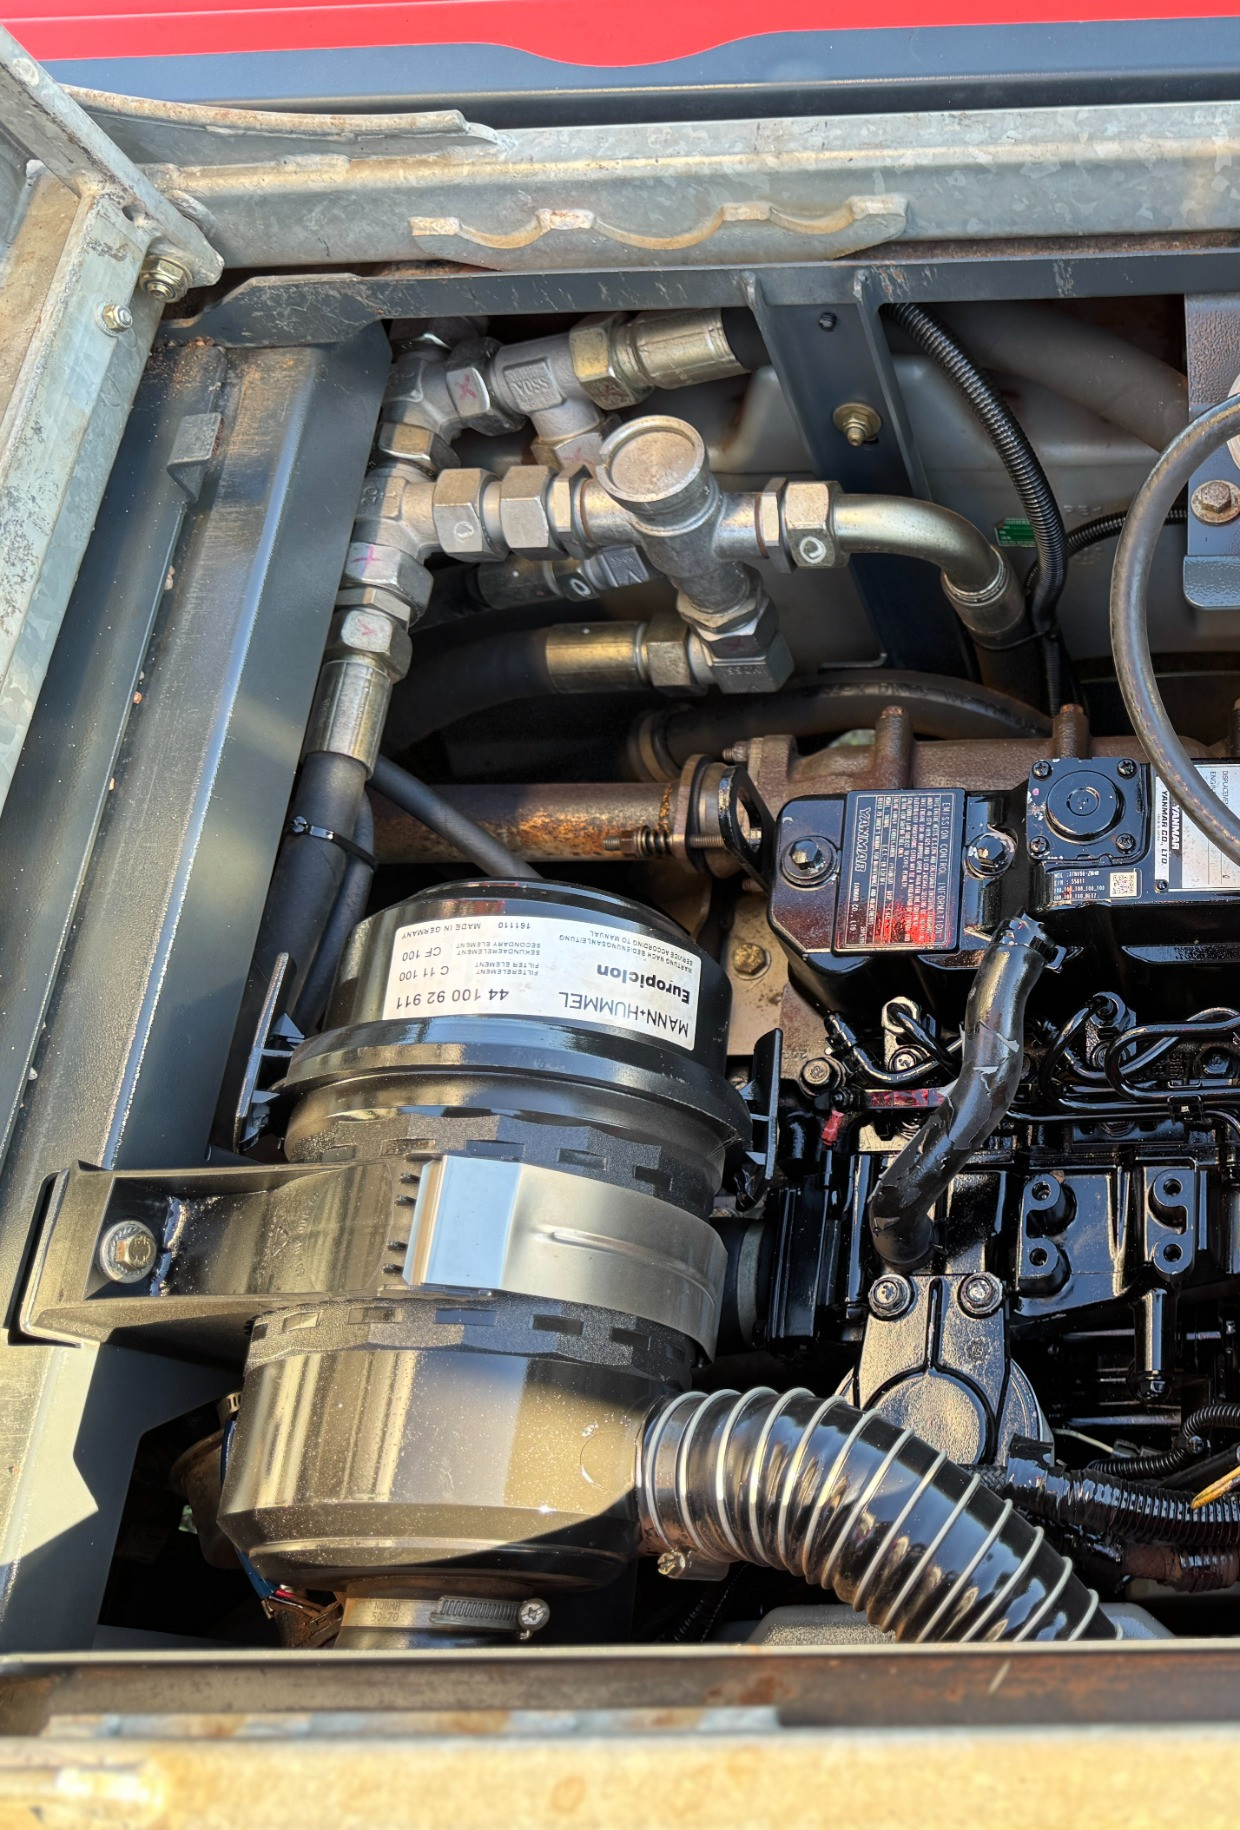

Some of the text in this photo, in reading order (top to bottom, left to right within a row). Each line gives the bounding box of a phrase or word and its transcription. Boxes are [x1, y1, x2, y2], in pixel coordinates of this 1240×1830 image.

[512, 378, 549, 396] VOSS
[1161, 791, 1169, 828] YANMAR
[854, 807, 871, 872] YANMAR
[1160, 830, 1168, 846] CO.,
[936, 803, 950, 934] EMISSION CONTROL INFORMATION
[401, 926, 441, 939] GERMANY
[455, 922, 481, 931] MADE
[402, 946, 442, 962] CF 100
[589, 930, 693, 966] SERVICE ACCORDING TO MANUAL
[399, 965, 449, 982] C 11 100
[596, 964, 690, 1004] Europiclon
[396, 988, 509, 1010] 44 100 92 911
[558, 991, 689, 1038] MANN+HUMMEL
